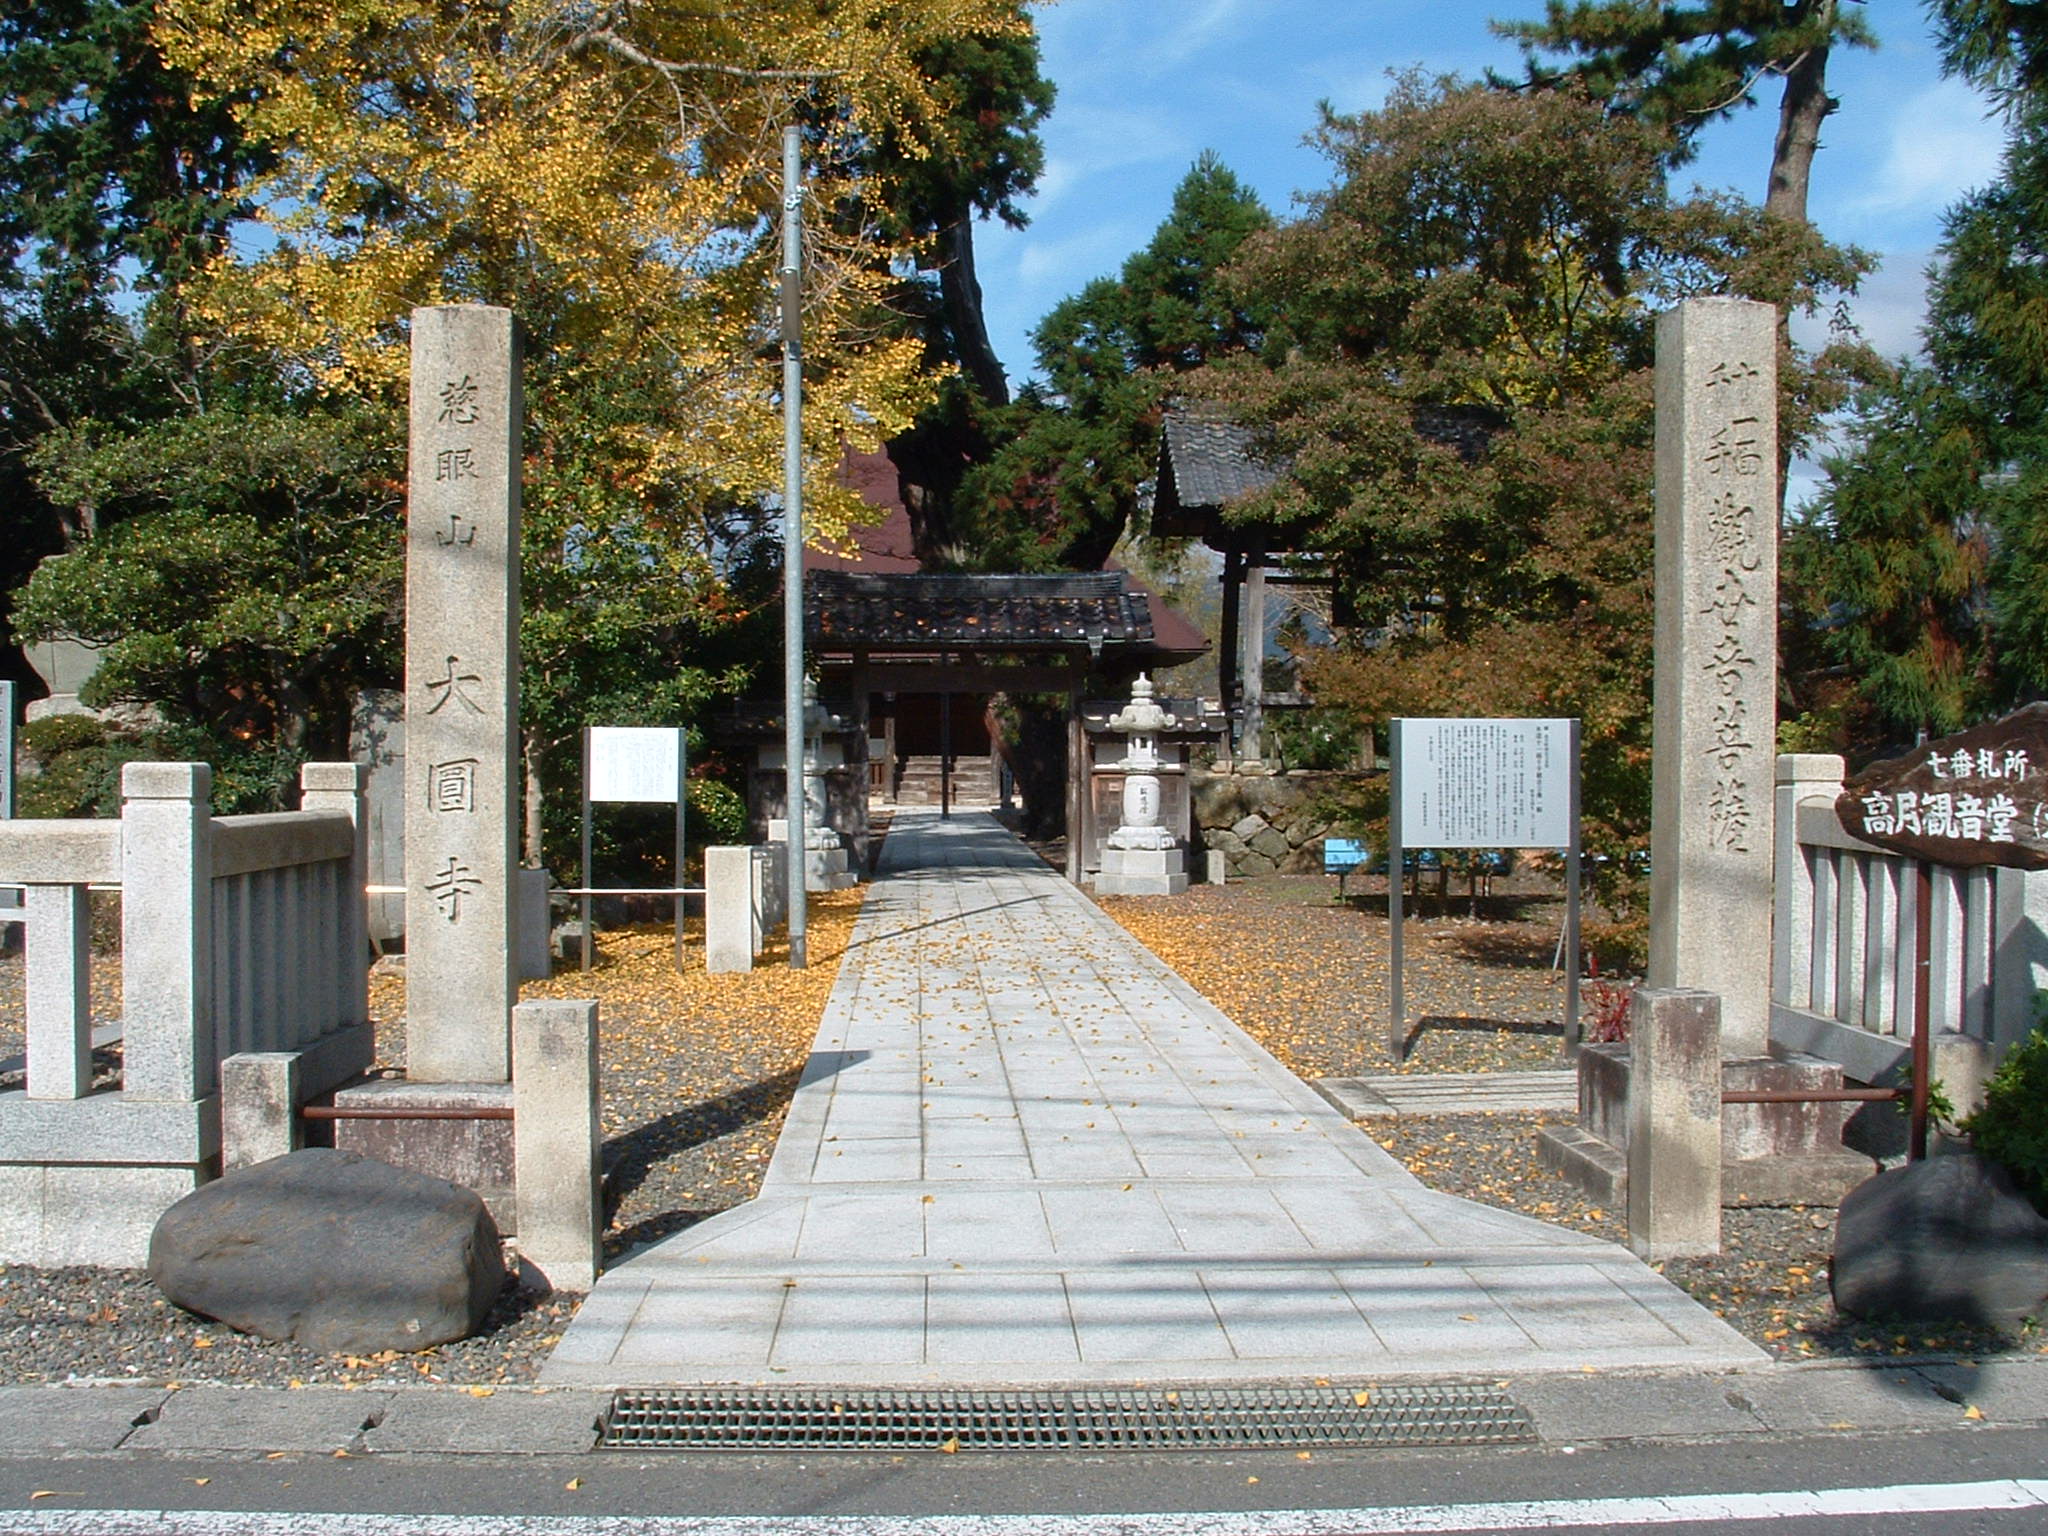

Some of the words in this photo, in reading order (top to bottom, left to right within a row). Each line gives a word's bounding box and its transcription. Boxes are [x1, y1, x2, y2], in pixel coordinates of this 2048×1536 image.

[433, 374, 481, 548] 慈眼山
[424, 655, 486, 922] 大圓寺
[1926, 748, 2030, 782] 七番札所
